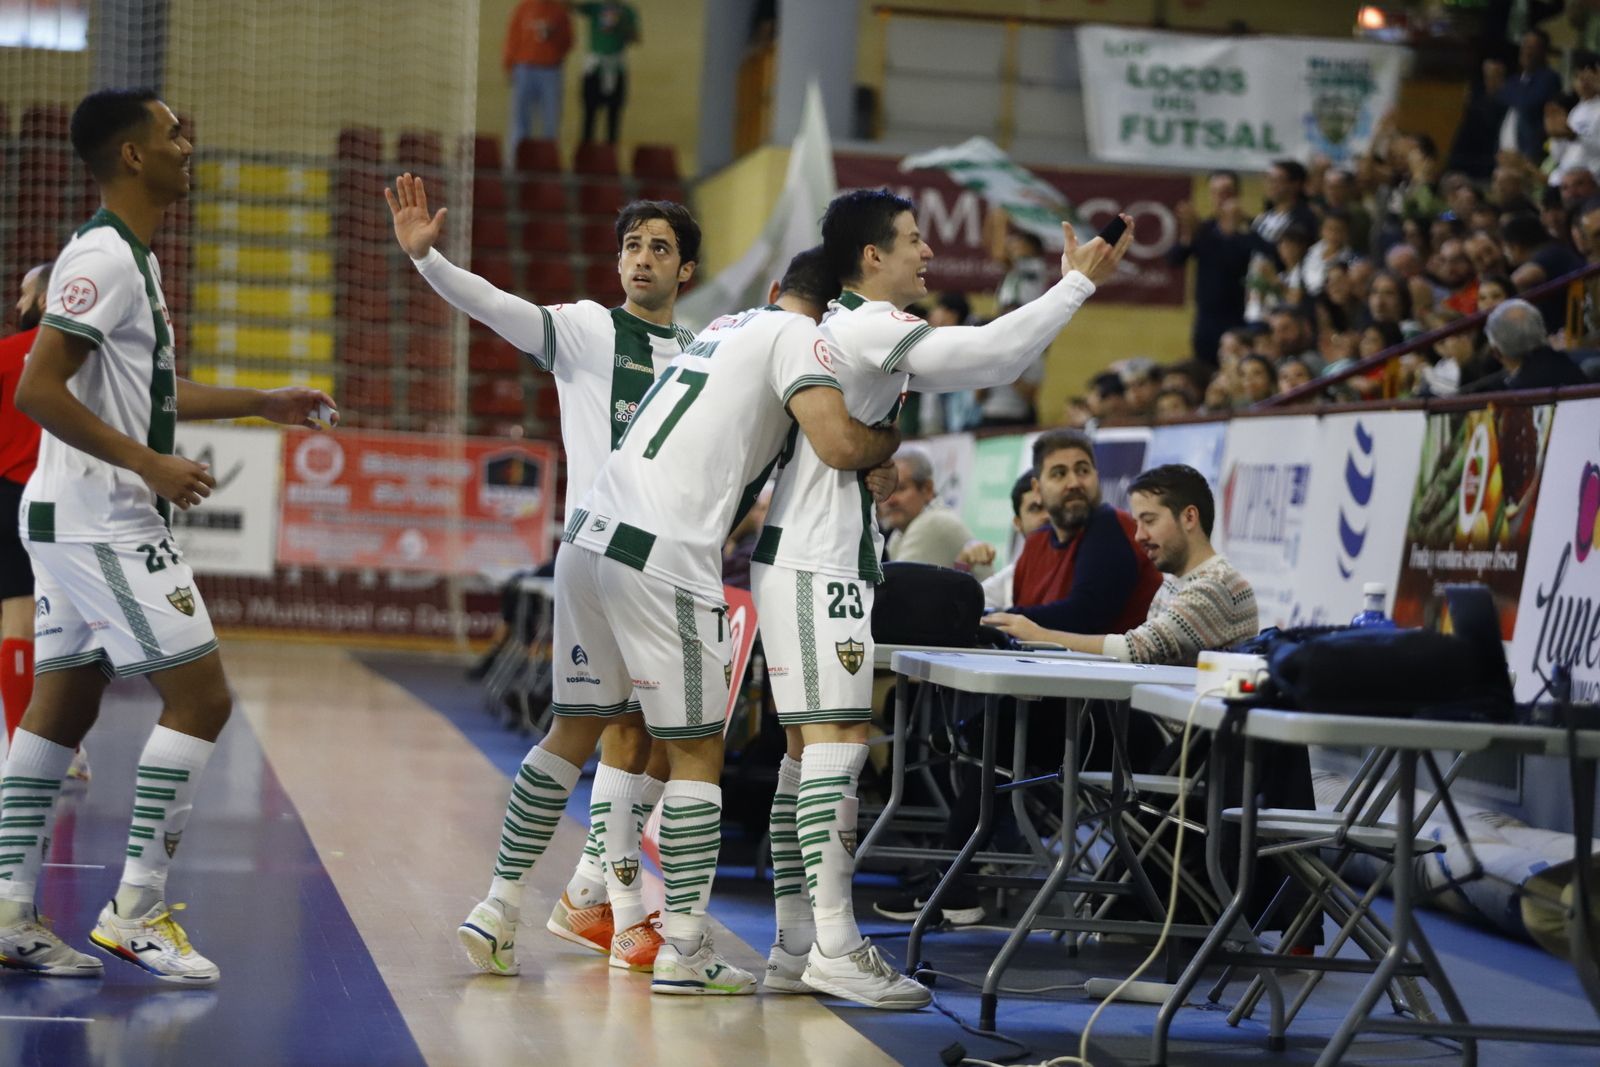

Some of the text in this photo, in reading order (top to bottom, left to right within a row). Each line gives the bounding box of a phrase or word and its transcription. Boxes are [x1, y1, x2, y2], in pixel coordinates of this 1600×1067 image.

[1125, 62, 1247, 94] LOCOS
[1119, 114, 1283, 152] FUTSAL
[616, 365, 709, 460] 17
[136, 538, 179, 574] 21
[827, 581, 864, 619] 23
